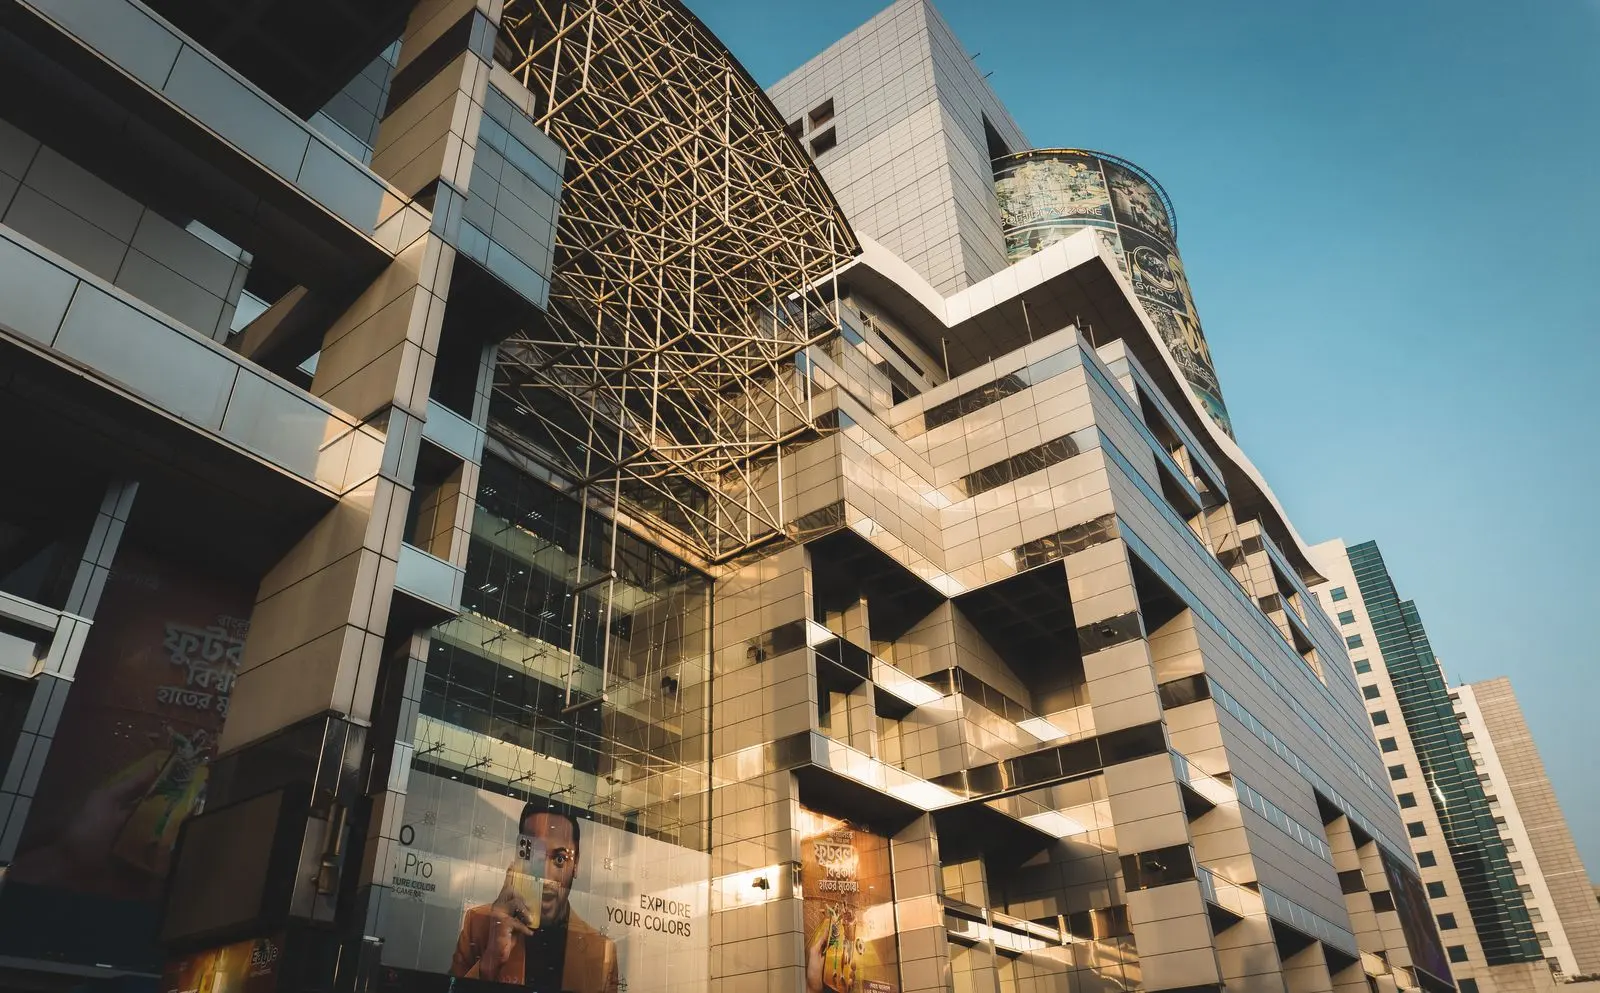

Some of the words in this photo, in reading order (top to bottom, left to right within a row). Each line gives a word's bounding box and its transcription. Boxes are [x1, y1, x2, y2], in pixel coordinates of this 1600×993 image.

[1068, 207, 1103, 216] ZONE
[1135, 281, 1164, 296] GYRO
[1164, 291, 1178, 304] VR
[404, 852, 433, 878] Pro
[411, 880, 436, 892] COLOR
[640, 893, 691, 919] EXPLORE
[606, 905, 641, 928] YOUR
[644, 914, 691, 937] COLORS
